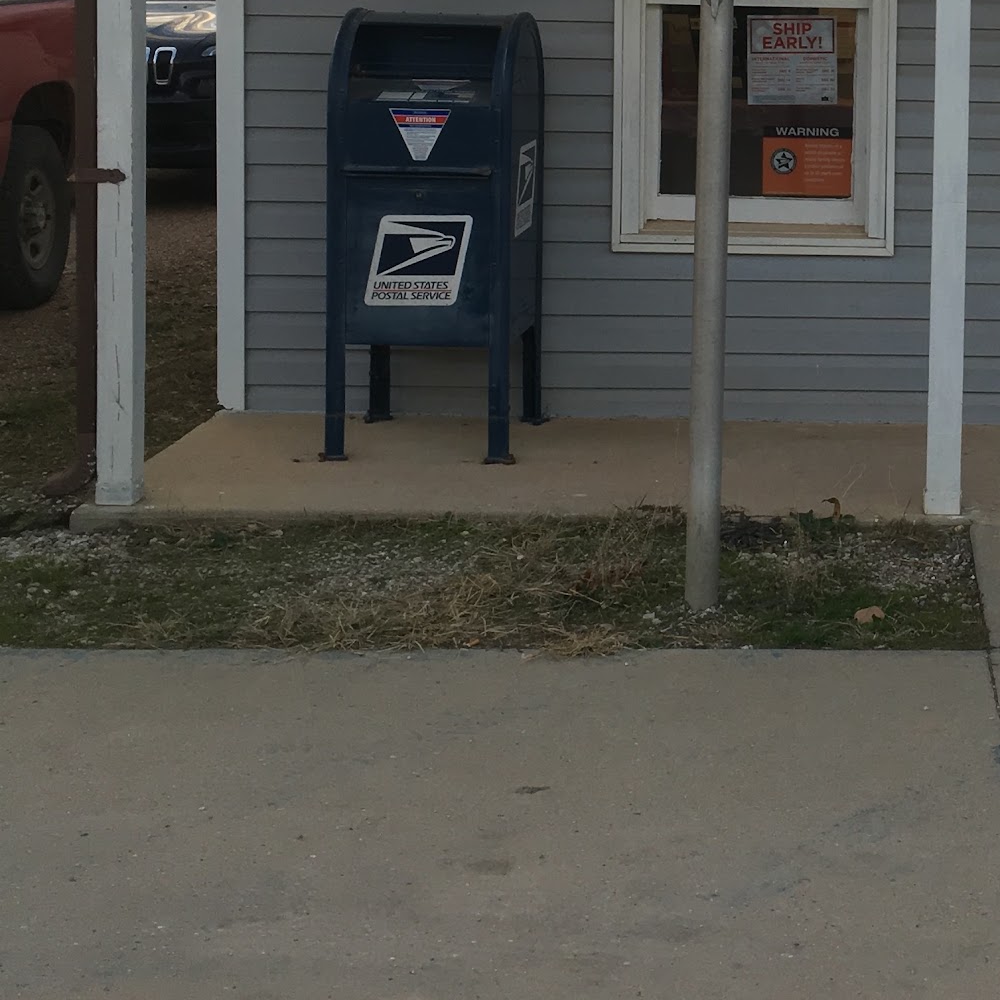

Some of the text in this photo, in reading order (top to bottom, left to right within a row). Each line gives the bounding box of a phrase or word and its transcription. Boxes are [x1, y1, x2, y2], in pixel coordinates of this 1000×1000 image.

[773, 22, 812, 35] SHIP
[762, 36, 823, 49] EARLY!
[775, 126, 840, 137] WARNING
[373, 281, 449, 290] UNITED STATES
[371, 291, 452, 300] POSTAL SERVICE
